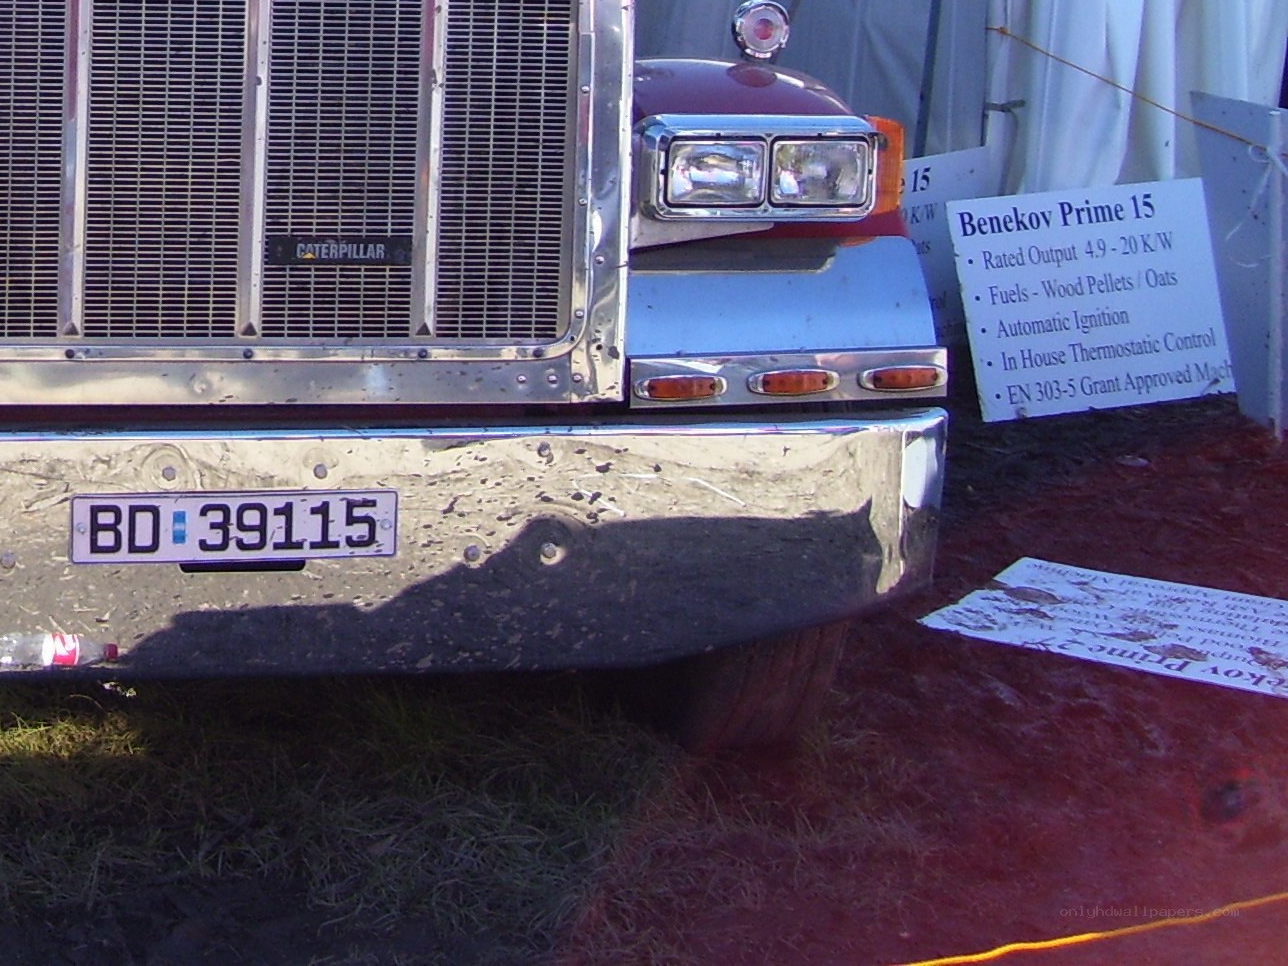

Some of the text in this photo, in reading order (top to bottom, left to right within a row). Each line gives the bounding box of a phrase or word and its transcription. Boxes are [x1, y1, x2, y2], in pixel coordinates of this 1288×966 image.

[912, 167, 931, 193] 15
[957, 193, 1155, 238] Benekov Prime 15
[296, 243, 385, 259] CATERPILLAR
[982, 247, 1025, 270] Rated
[1028, 244, 1078, 268] Output
[1085, 238, 1106, 259] 4.9
[1121, 235, 1137, 255] 20
[989, 283, 1029, 306] Fuels
[1041, 278, 1085, 300] Wood
[1087, 272, 1133, 295] Pellets
[1145, 268, 1178, 289] Oats
[997, 306, 1130, 339] Automatic Ignition
[1001, 327, 1216, 371] In House Thermostatic Control
[1007, 384, 1032, 405] EN
[1036, 378, 1077, 402] 303-5
[1081, 375, 1122, 396] Grant
[1124, 364, 1192, 396] Approved
[90, 499, 377, 554] BD 39115
